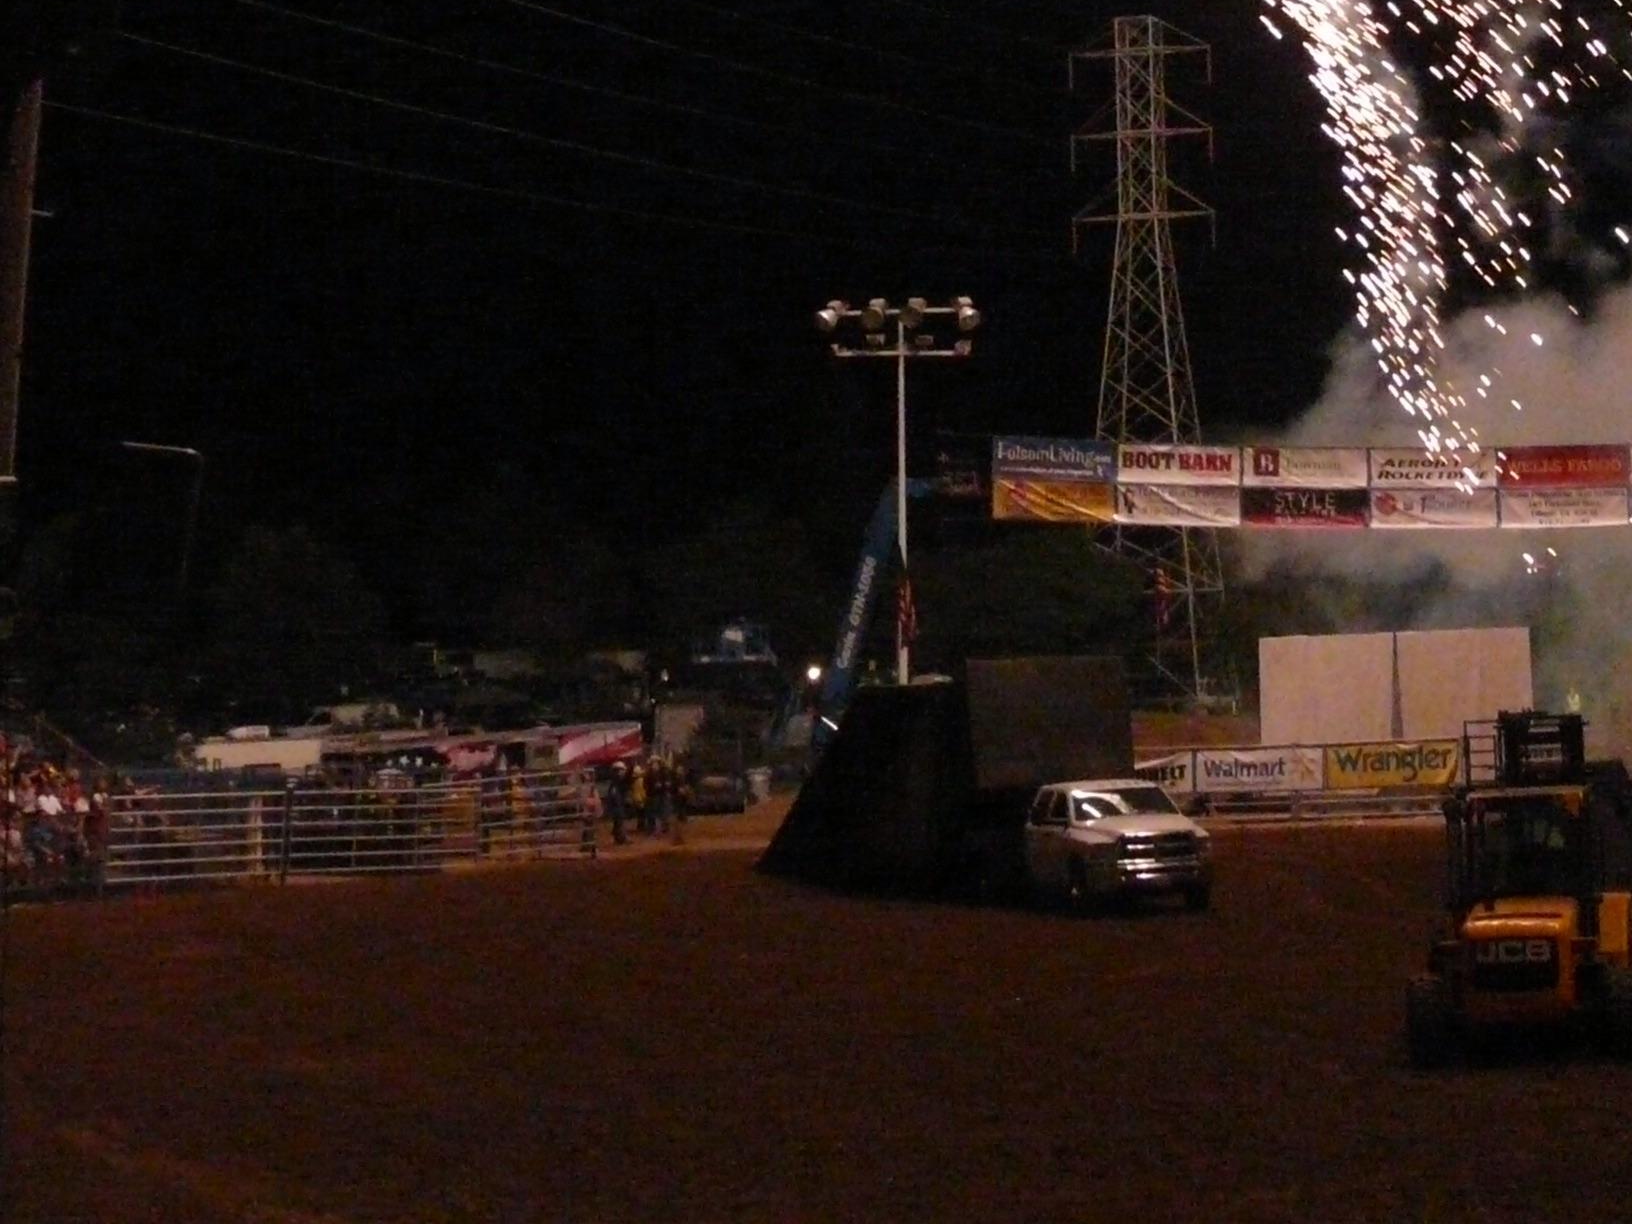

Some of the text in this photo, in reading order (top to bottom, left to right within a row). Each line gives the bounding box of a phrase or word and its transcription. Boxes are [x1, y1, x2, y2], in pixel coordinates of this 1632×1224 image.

[1122, 451, 1233, 472] BOOT BARN
[1377, 469, 1488, 480] ROCKETDYE
[1274, 491, 1336, 509] STYLE
[1203, 755, 1286, 779] Walmart
[1337, 744, 1454, 781] Wrangler
[1476, 941, 1552, 963] JCB
